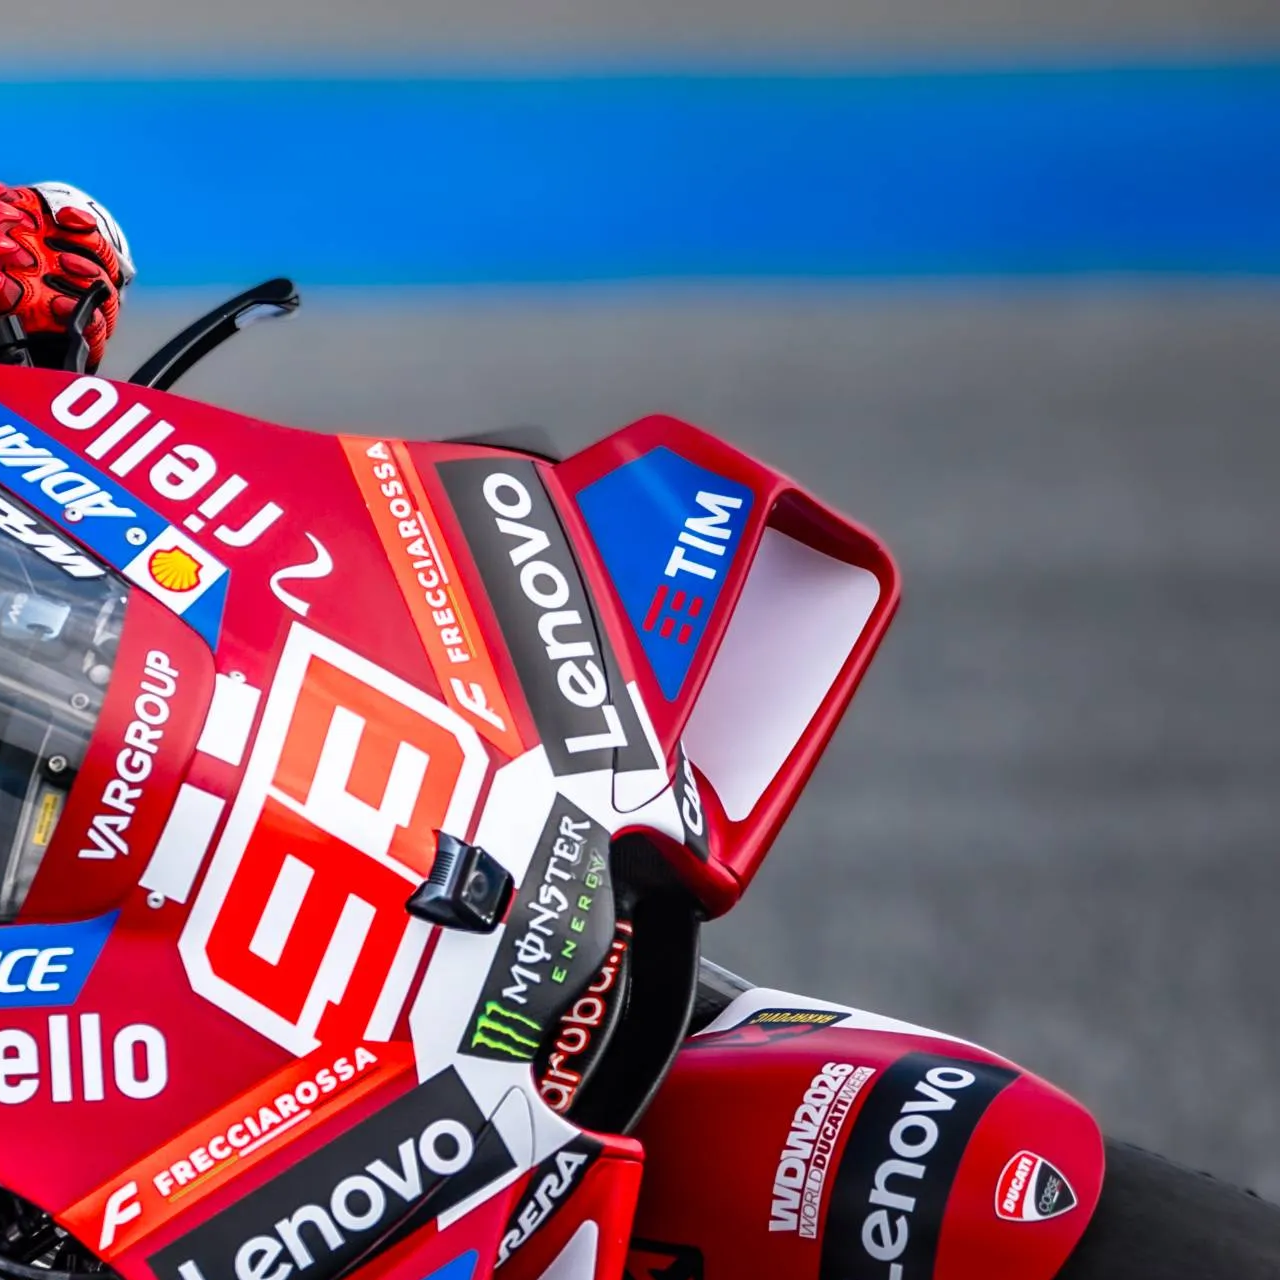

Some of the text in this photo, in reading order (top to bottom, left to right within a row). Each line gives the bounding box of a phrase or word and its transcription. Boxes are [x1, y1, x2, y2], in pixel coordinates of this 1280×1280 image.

[49, 374, 285, 548] riello
[664, 490, 743, 581] TIM
[367, 441, 476, 664] FRECCIAROSSA
[483, 472, 628, 756] Lenovo
[77, 649, 182, 860] VARGROUP
[502, 814, 591, 1004] MONSTER
[551, 848, 609, 983] ENERGY
[153, 1046, 378, 1197] FRECCIAROSSA
[769, 1061, 855, 1233] WDW2026
[1002, 1156, 1033, 1213] DUCATI
